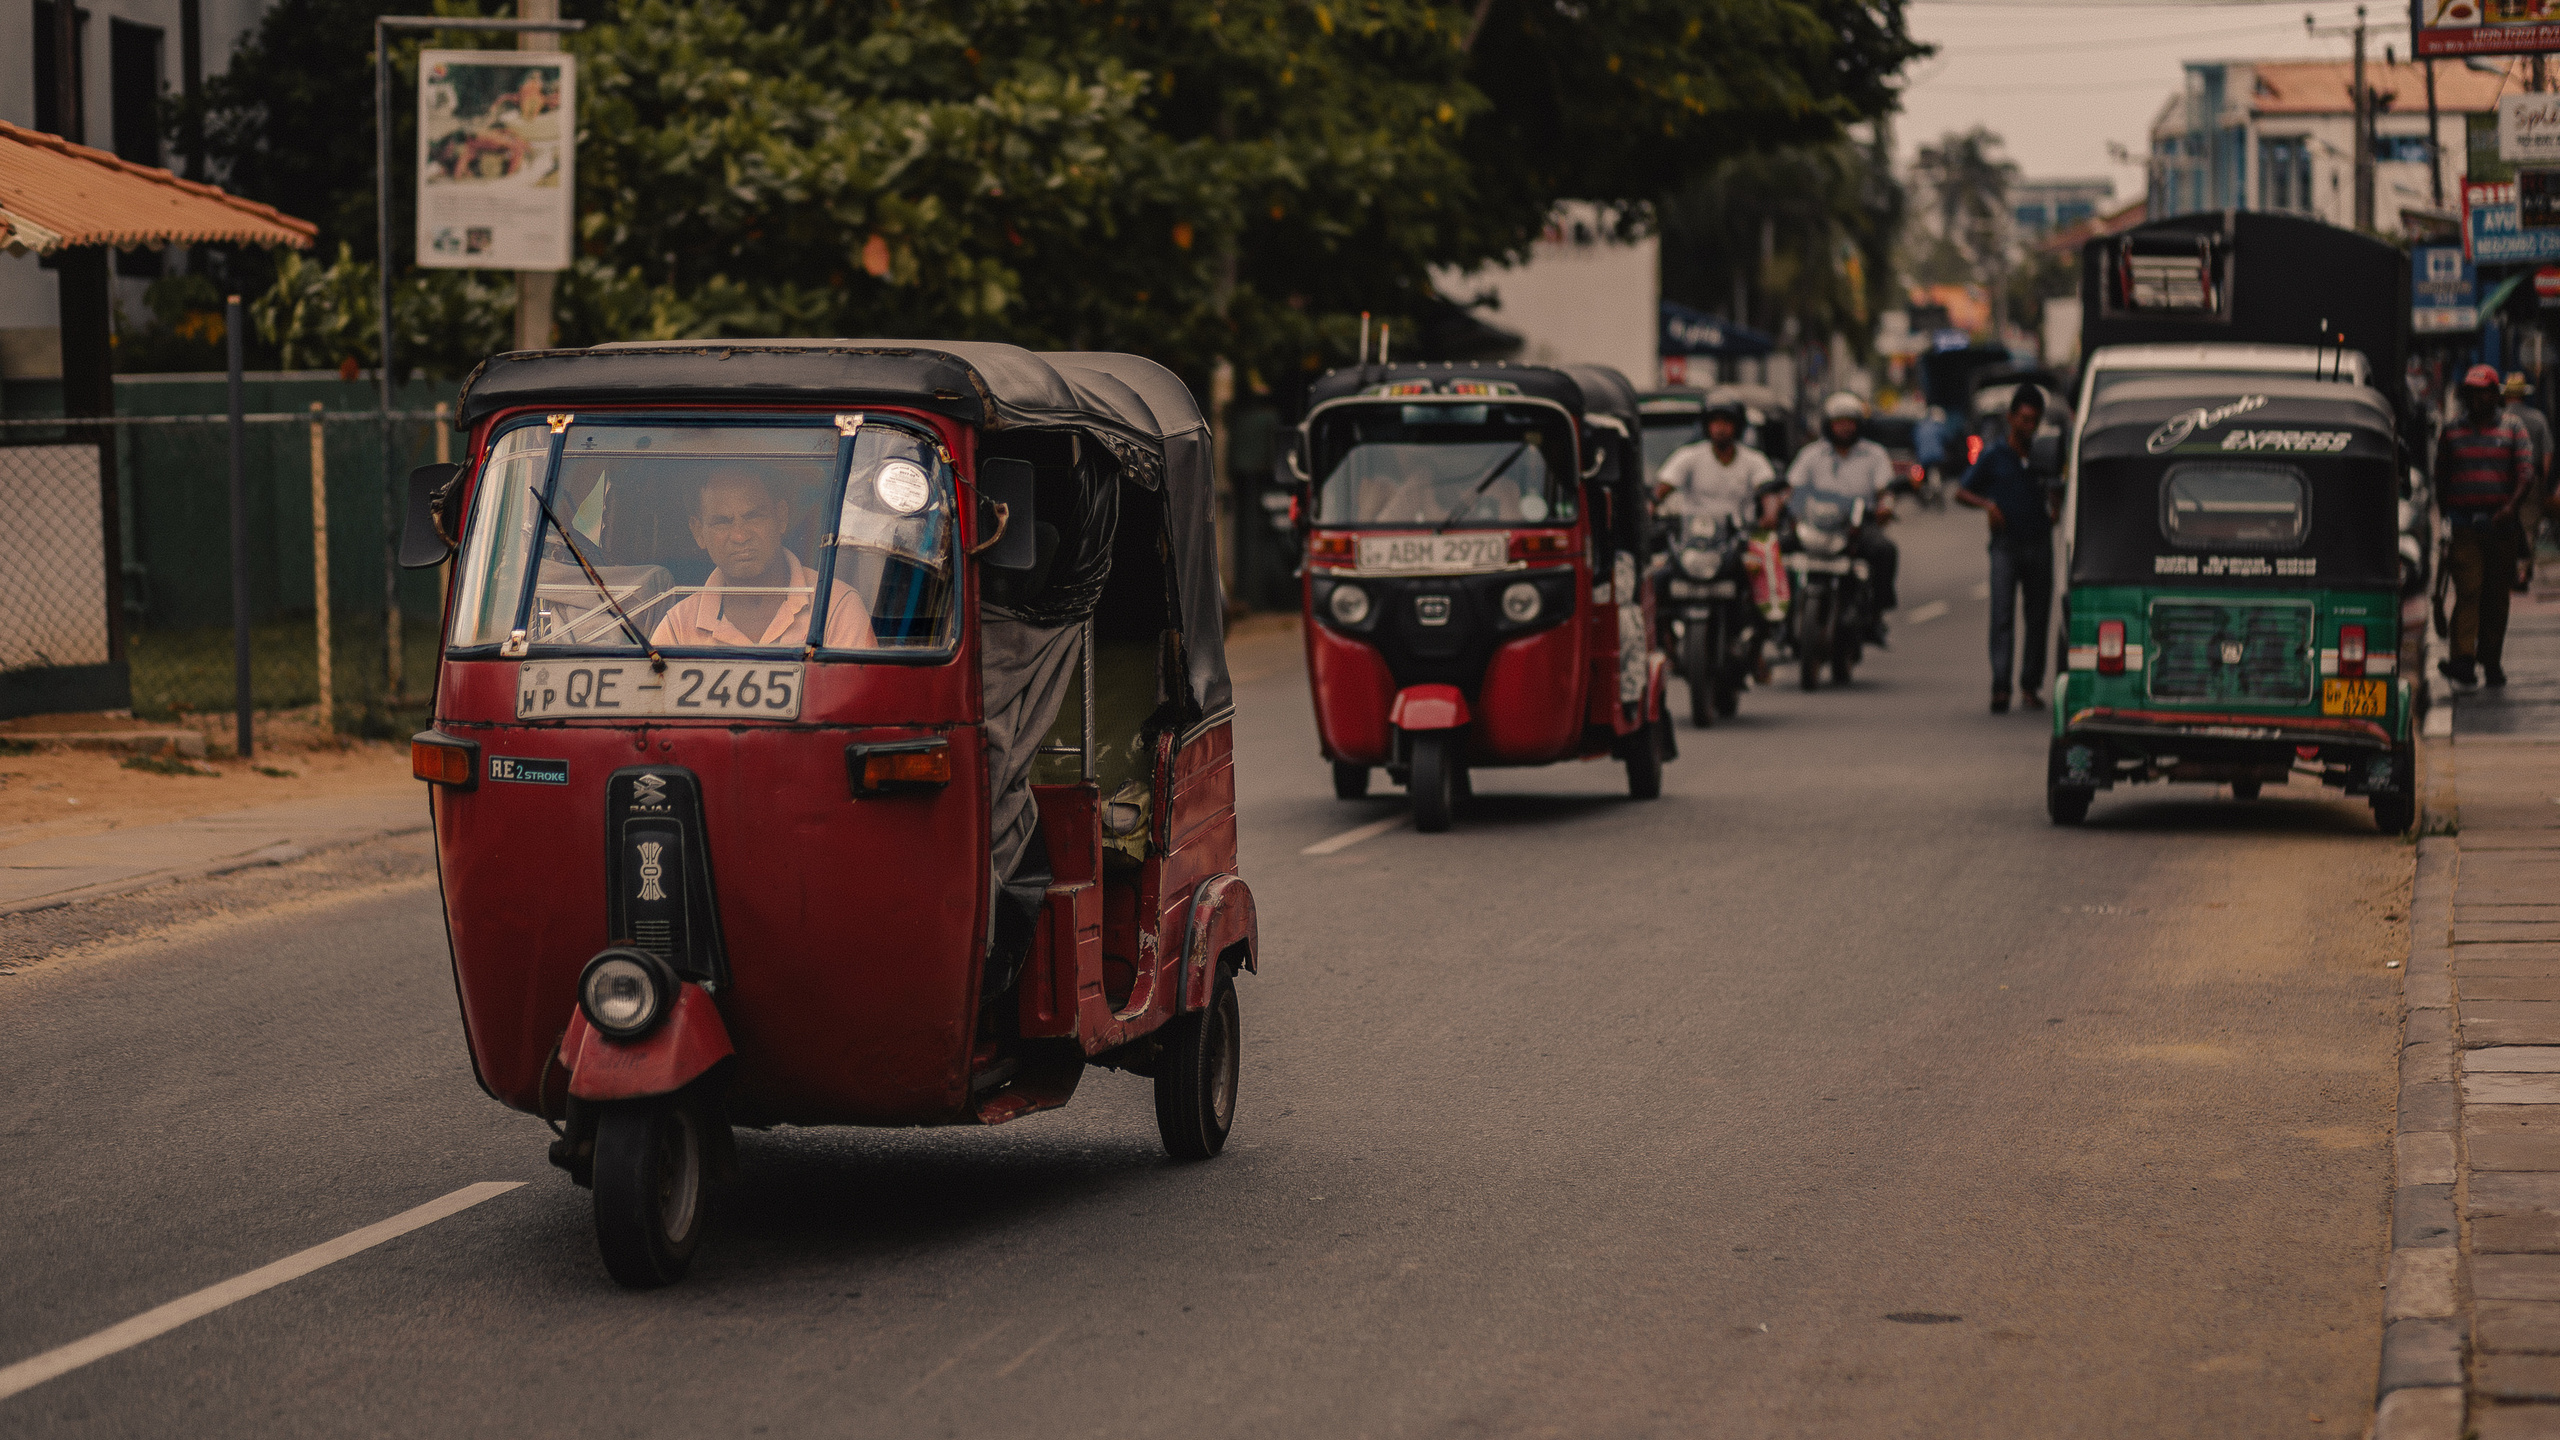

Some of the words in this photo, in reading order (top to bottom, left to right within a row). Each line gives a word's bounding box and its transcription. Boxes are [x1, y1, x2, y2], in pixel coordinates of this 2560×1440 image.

[2221, 429, 2353, 452] EXPRESS
[1389, 542, 1434, 563] ABM
[1444, 539, 1500, 562] 2970
[565, 668, 624, 708] QE
[676, 669, 795, 710] 2465
[492, 760, 515, 778] RE
[516, 765, 524, 779] 2
[524, 771, 566, 782] STROKE
